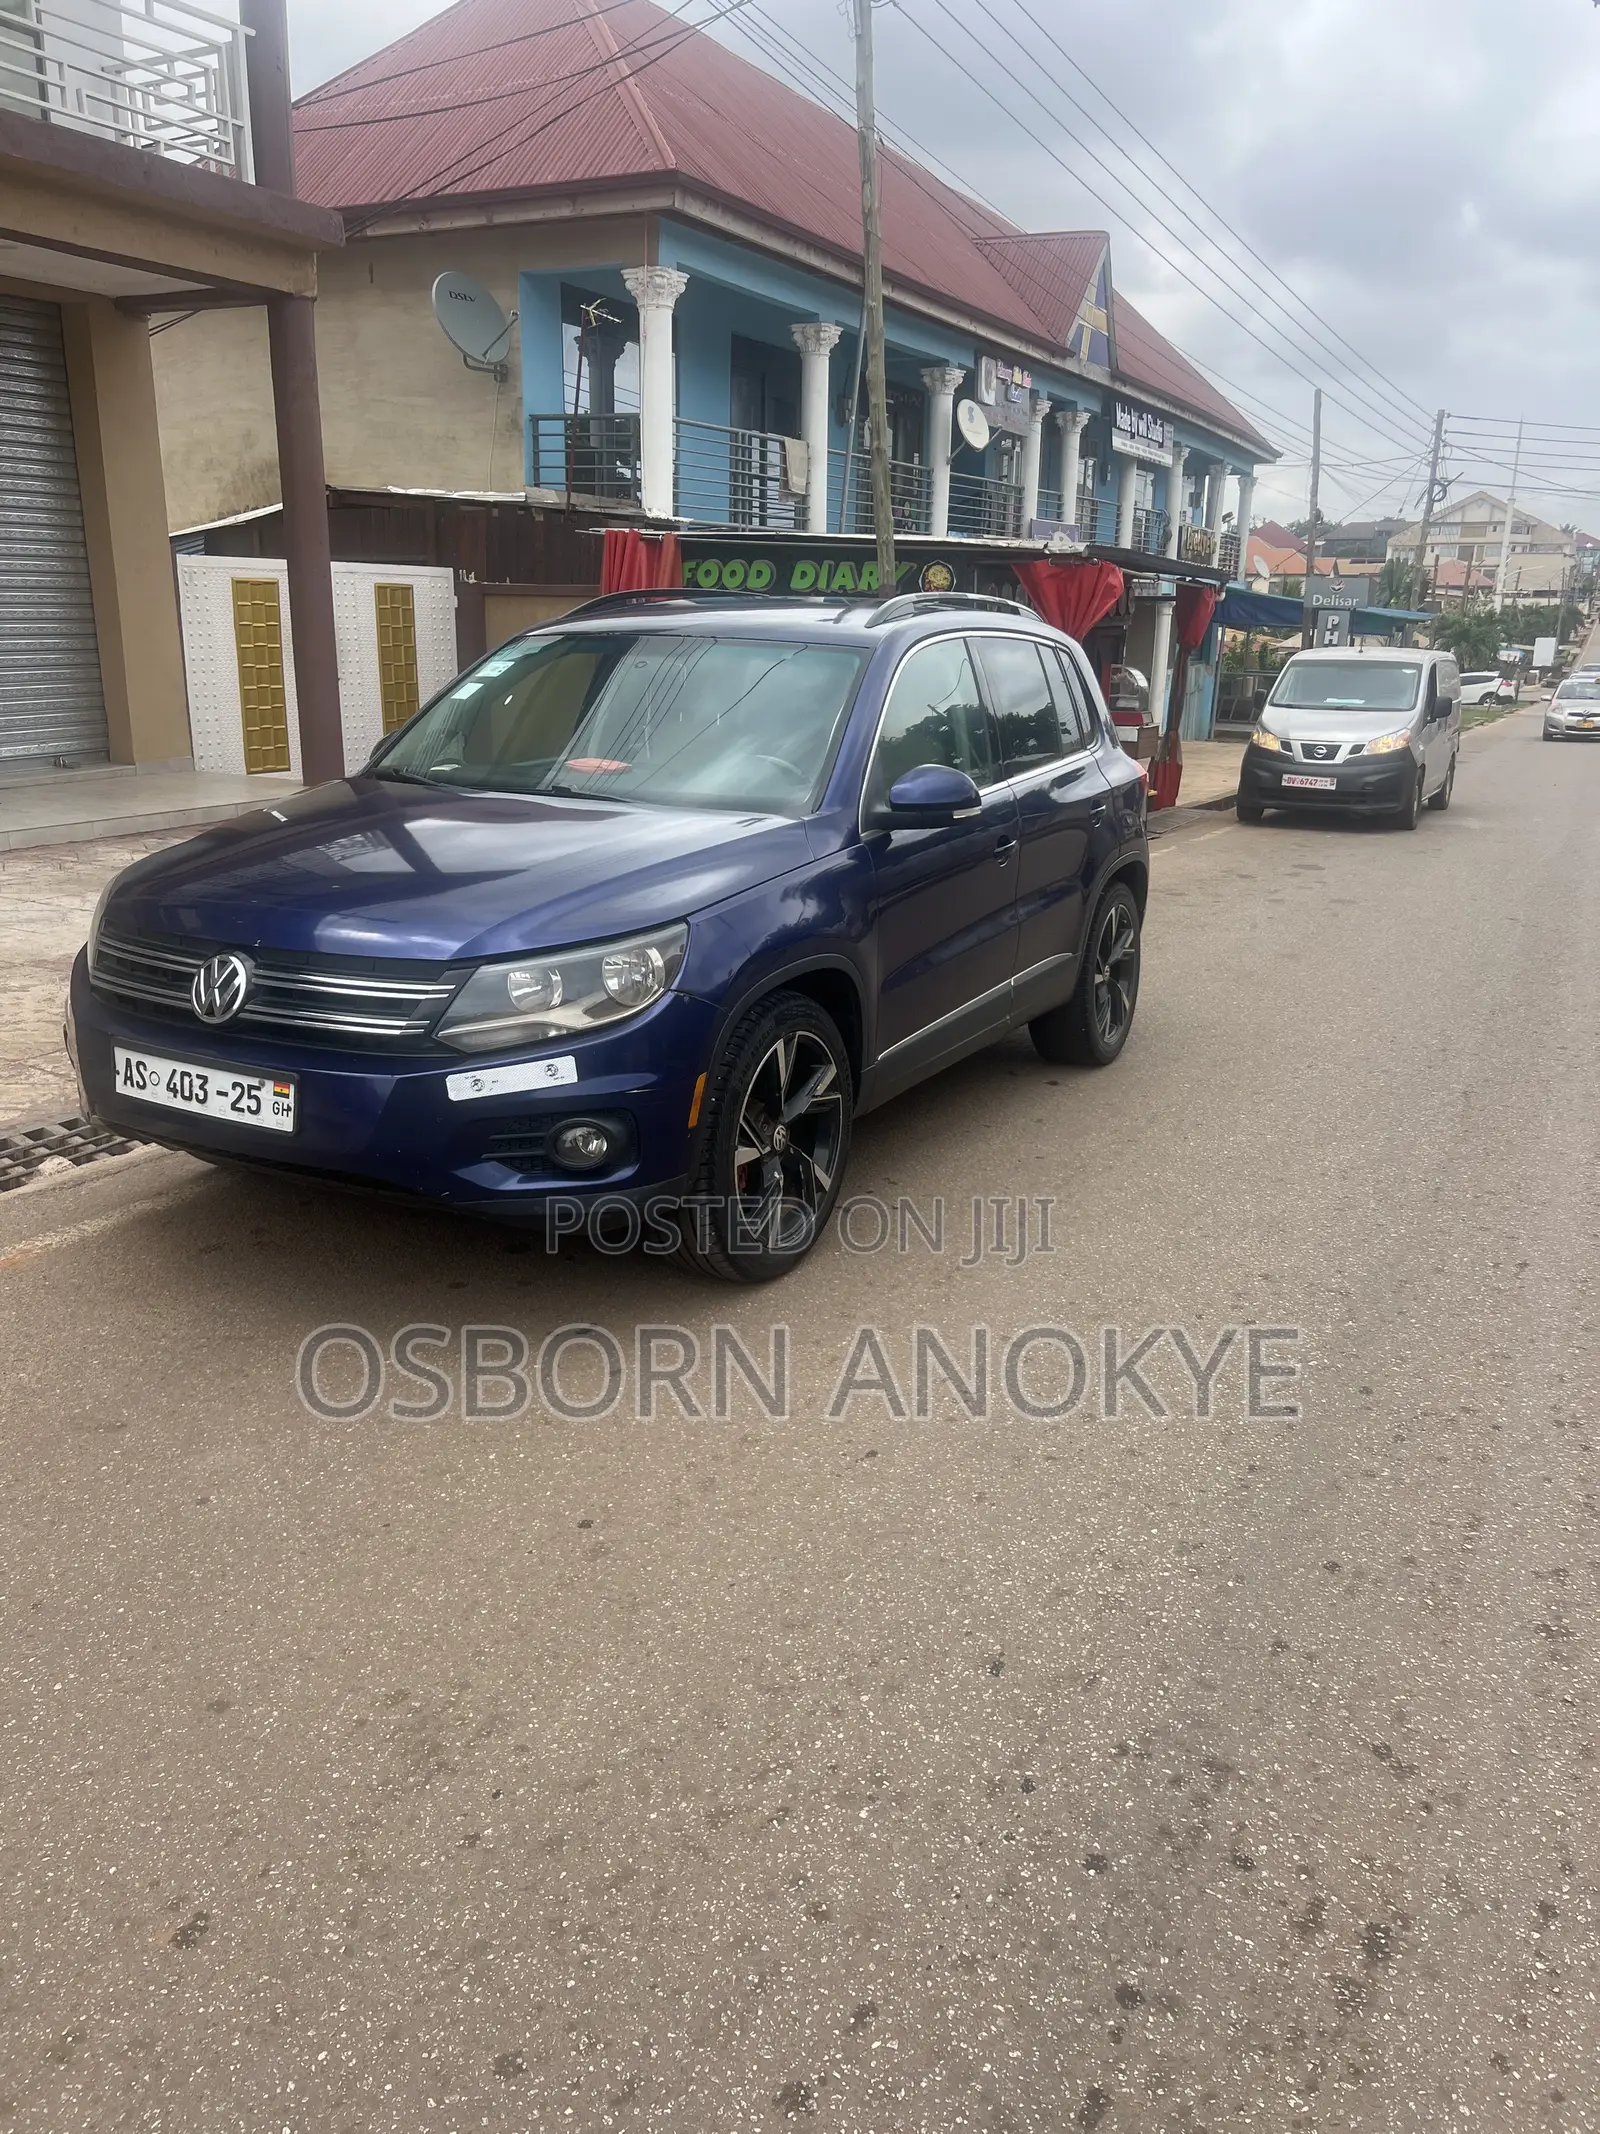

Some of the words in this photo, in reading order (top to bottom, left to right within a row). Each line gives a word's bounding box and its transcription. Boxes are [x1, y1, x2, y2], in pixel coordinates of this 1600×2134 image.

[682, 559, 776, 592] FOOD
[1312, 593, 1359, 607] Delisar
[123, 1057, 147, 1090] AS
[272, 1101, 291, 1118] GH
